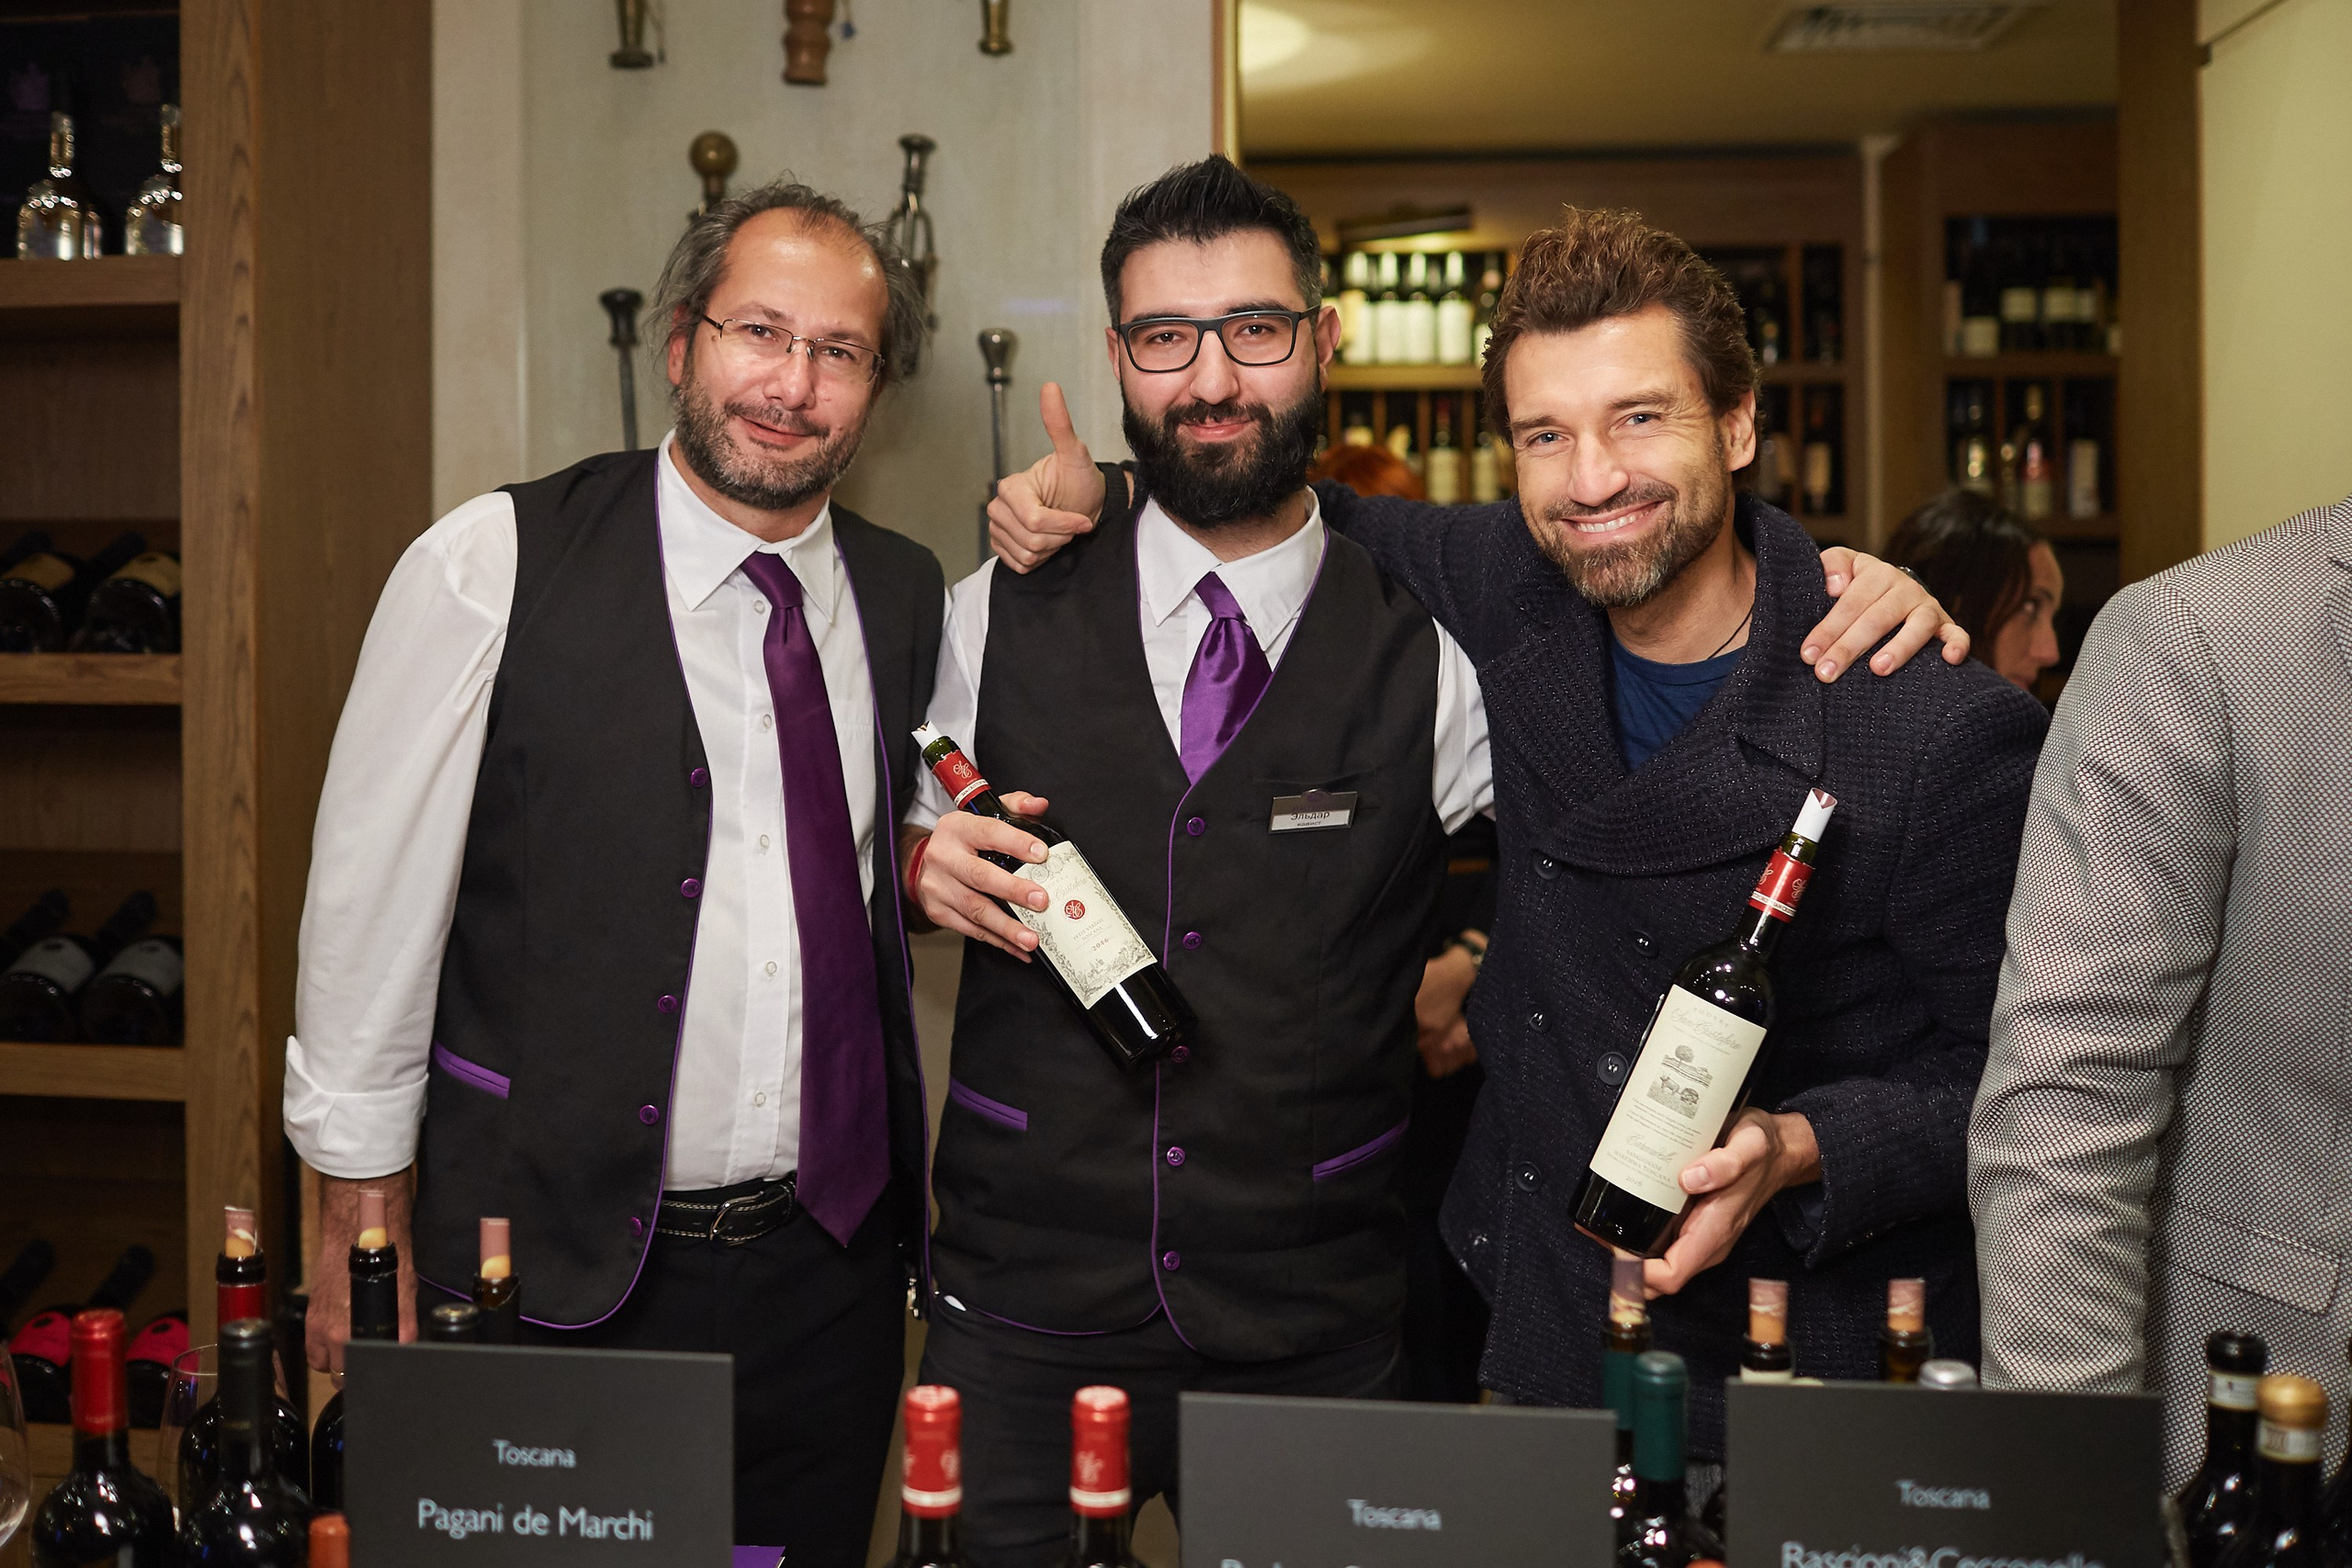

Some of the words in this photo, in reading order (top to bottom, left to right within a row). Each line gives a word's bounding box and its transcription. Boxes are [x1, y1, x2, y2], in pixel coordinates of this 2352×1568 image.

[1290, 811, 1330, 821] Эльдар
[1092, 938, 1109, 951] 2016
[492, 1438, 576, 1468] Toscana
[1894, 1478, 1991, 1509] Toscana
[418, 1497, 504, 1540] Pagani
[513, 1505, 550, 1536] de
[559, 1506, 654, 1540] Marchi
[1347, 1498, 1442, 1531] Toscana
